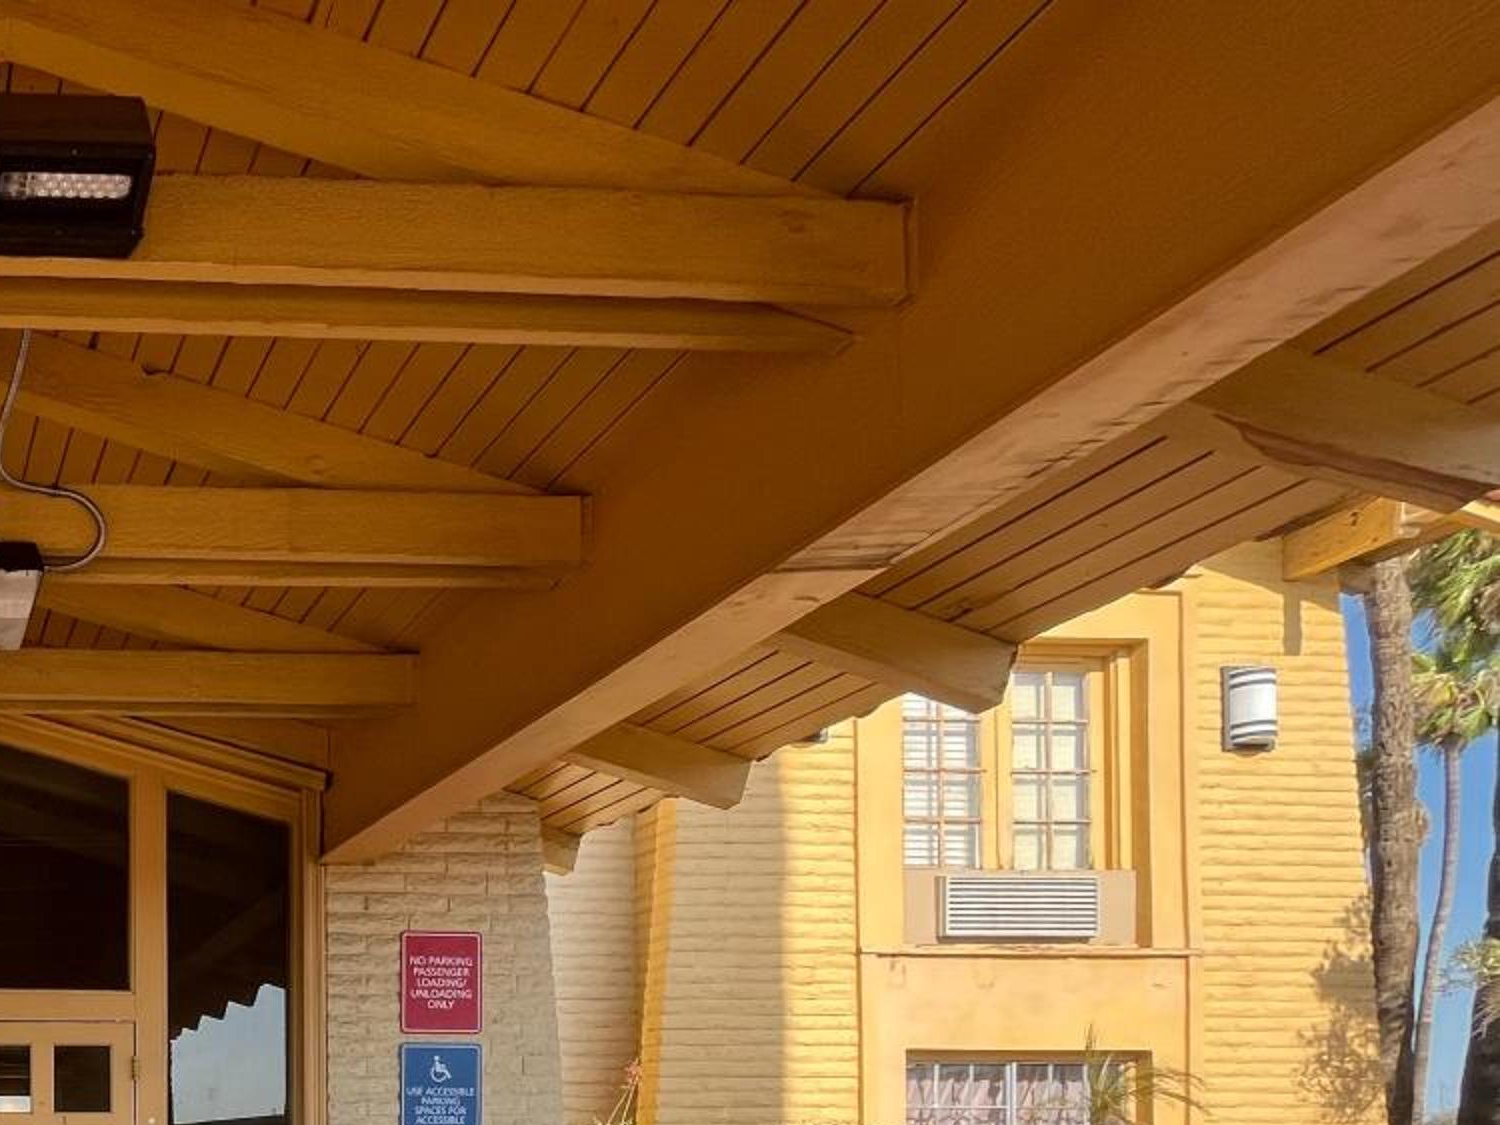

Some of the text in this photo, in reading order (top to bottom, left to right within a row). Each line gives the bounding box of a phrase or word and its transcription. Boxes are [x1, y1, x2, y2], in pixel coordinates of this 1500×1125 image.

[409, 957, 473, 967] NO PARKING
[413, 967, 470, 977] PASSENGER
[416, 978, 466, 987] LOADING/
[412, 988, 472, 999] UNLOADING
[427, 1000, 454, 1009] ONLY
[406, 1087, 475, 1096] USE ACCESSIBLE
[421, 1097, 460, 1106] PARKING
[414, 1106, 467, 1115] SPACES FOR
[416, 1116, 465, 1125] ACCESSIBLE
